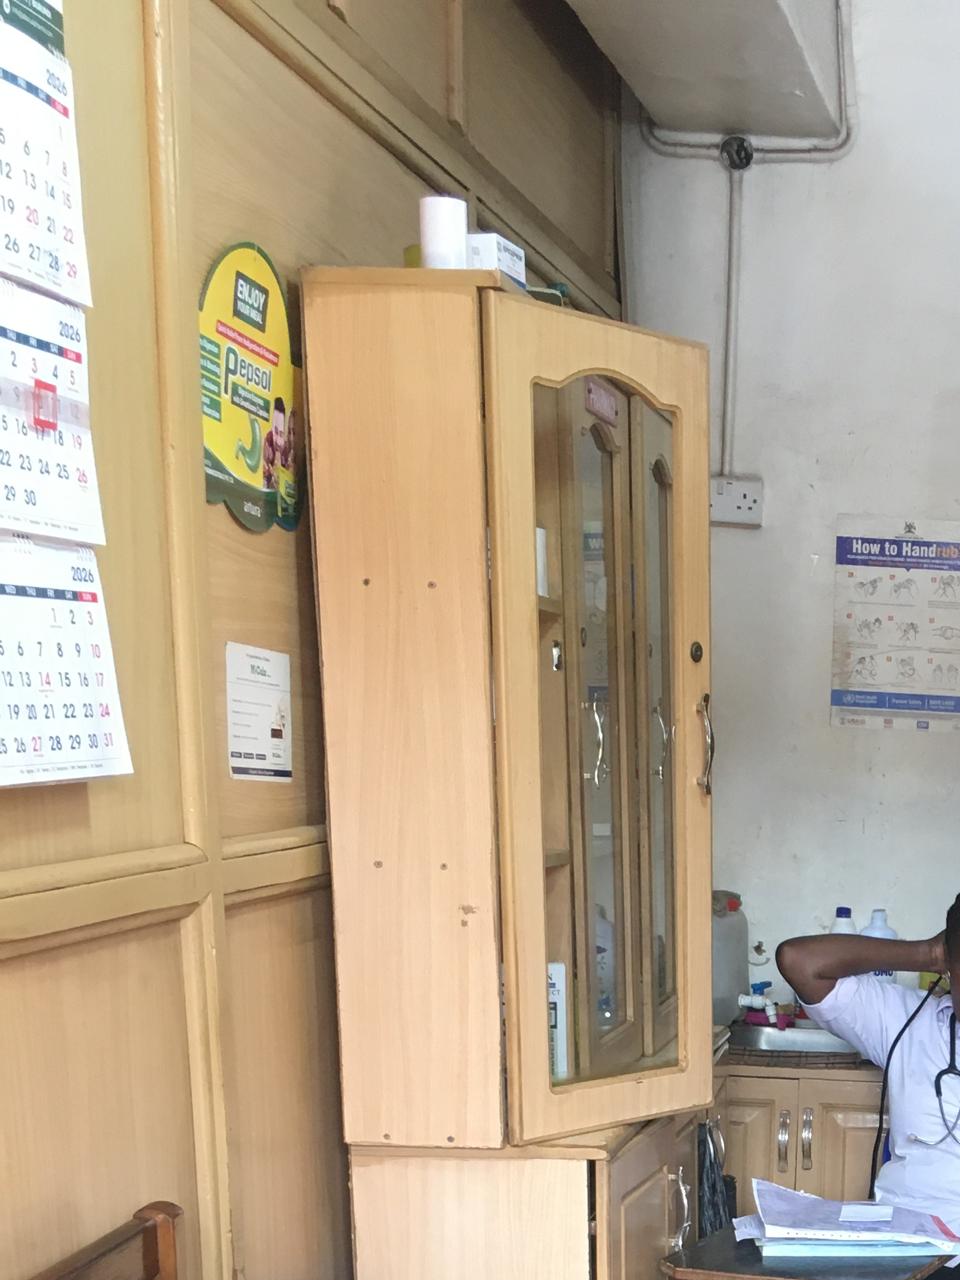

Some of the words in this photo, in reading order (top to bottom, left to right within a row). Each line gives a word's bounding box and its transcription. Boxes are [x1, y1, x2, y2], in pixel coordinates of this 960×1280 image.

[46, 68, 68, 97] 2026
[23, 140, 31, 156] 6
[45, 151, 51, 166] 7
[23, 169, 37, 190] 13
[44, 182, 55, 201] 14
[62, 190, 72, 210] 15
[1, 194, 15, 214] 19
[26, 206, 39, 226] 20
[47, 216, 56, 235] 21
[63, 225, 75, 245] 22
[4, 234, 20, 254] 26
[29, 243, 41, 261] 27
[48, 252, 60, 273] 28
[66, 262, 77, 279] 29
[236, 278, 266, 311] ENJOY
[59, 320, 81, 343] 2026
[11, 350, 17, 368] 2
[32, 357, 38, 374] 3
[52, 364, 58, 380] 4
[69, 370, 75, 386] 5
[223, 345, 273, 395] Pepsol
[15, 418, 28, 436] 16
[54, 429, 64, 446] 18
[71, 432, 82, 450] 19
[0, 449, 12, 467] 22
[19, 453, 32, 471] 23
[38, 458, 51, 475] 24
[56, 463, 70, 480] 25
[76, 467, 88, 484] 26
[4, 485, 16, 501] 29
[24, 489, 36, 506] 30
[852, 539, 881, 554] How
[885, 541, 897, 555] to
[71, 566, 94, 583] 2026
[51, 608, 57, 623] 1
[70, 609, 76, 625] 2
[88, 611, 94, 626] 3
[18, 641, 24, 656] 6
[37, 641, 42, 657] 7
[57, 642, 63, 658] 8
[75, 643, 81, 658] 9
[91, 644, 101, 659] 10
[2, 671, 14, 687] 12
[19, 672, 32, 687] 13
[39, 672, 51, 687] 14
[58, 672, 71, 687] 15
[78, 672, 89, 687] 16
[95, 672, 104, 688] 17
[8, 704, 20, 720] 19
[26, 704, 37, 720] 20
[44, 704, 55, 720] 21
[63, 704, 76, 719] 22
[83, 704, 94, 719] 23
[100, 703, 110, 718] 24
[14, 737, 26, 753] 26
[32, 737, 42, 752] 27
[49, 736, 62, 752] 28
[69, 735, 81, 750] 29
[88, 734, 99, 750] 30
[104, 733, 114, 747] 31
